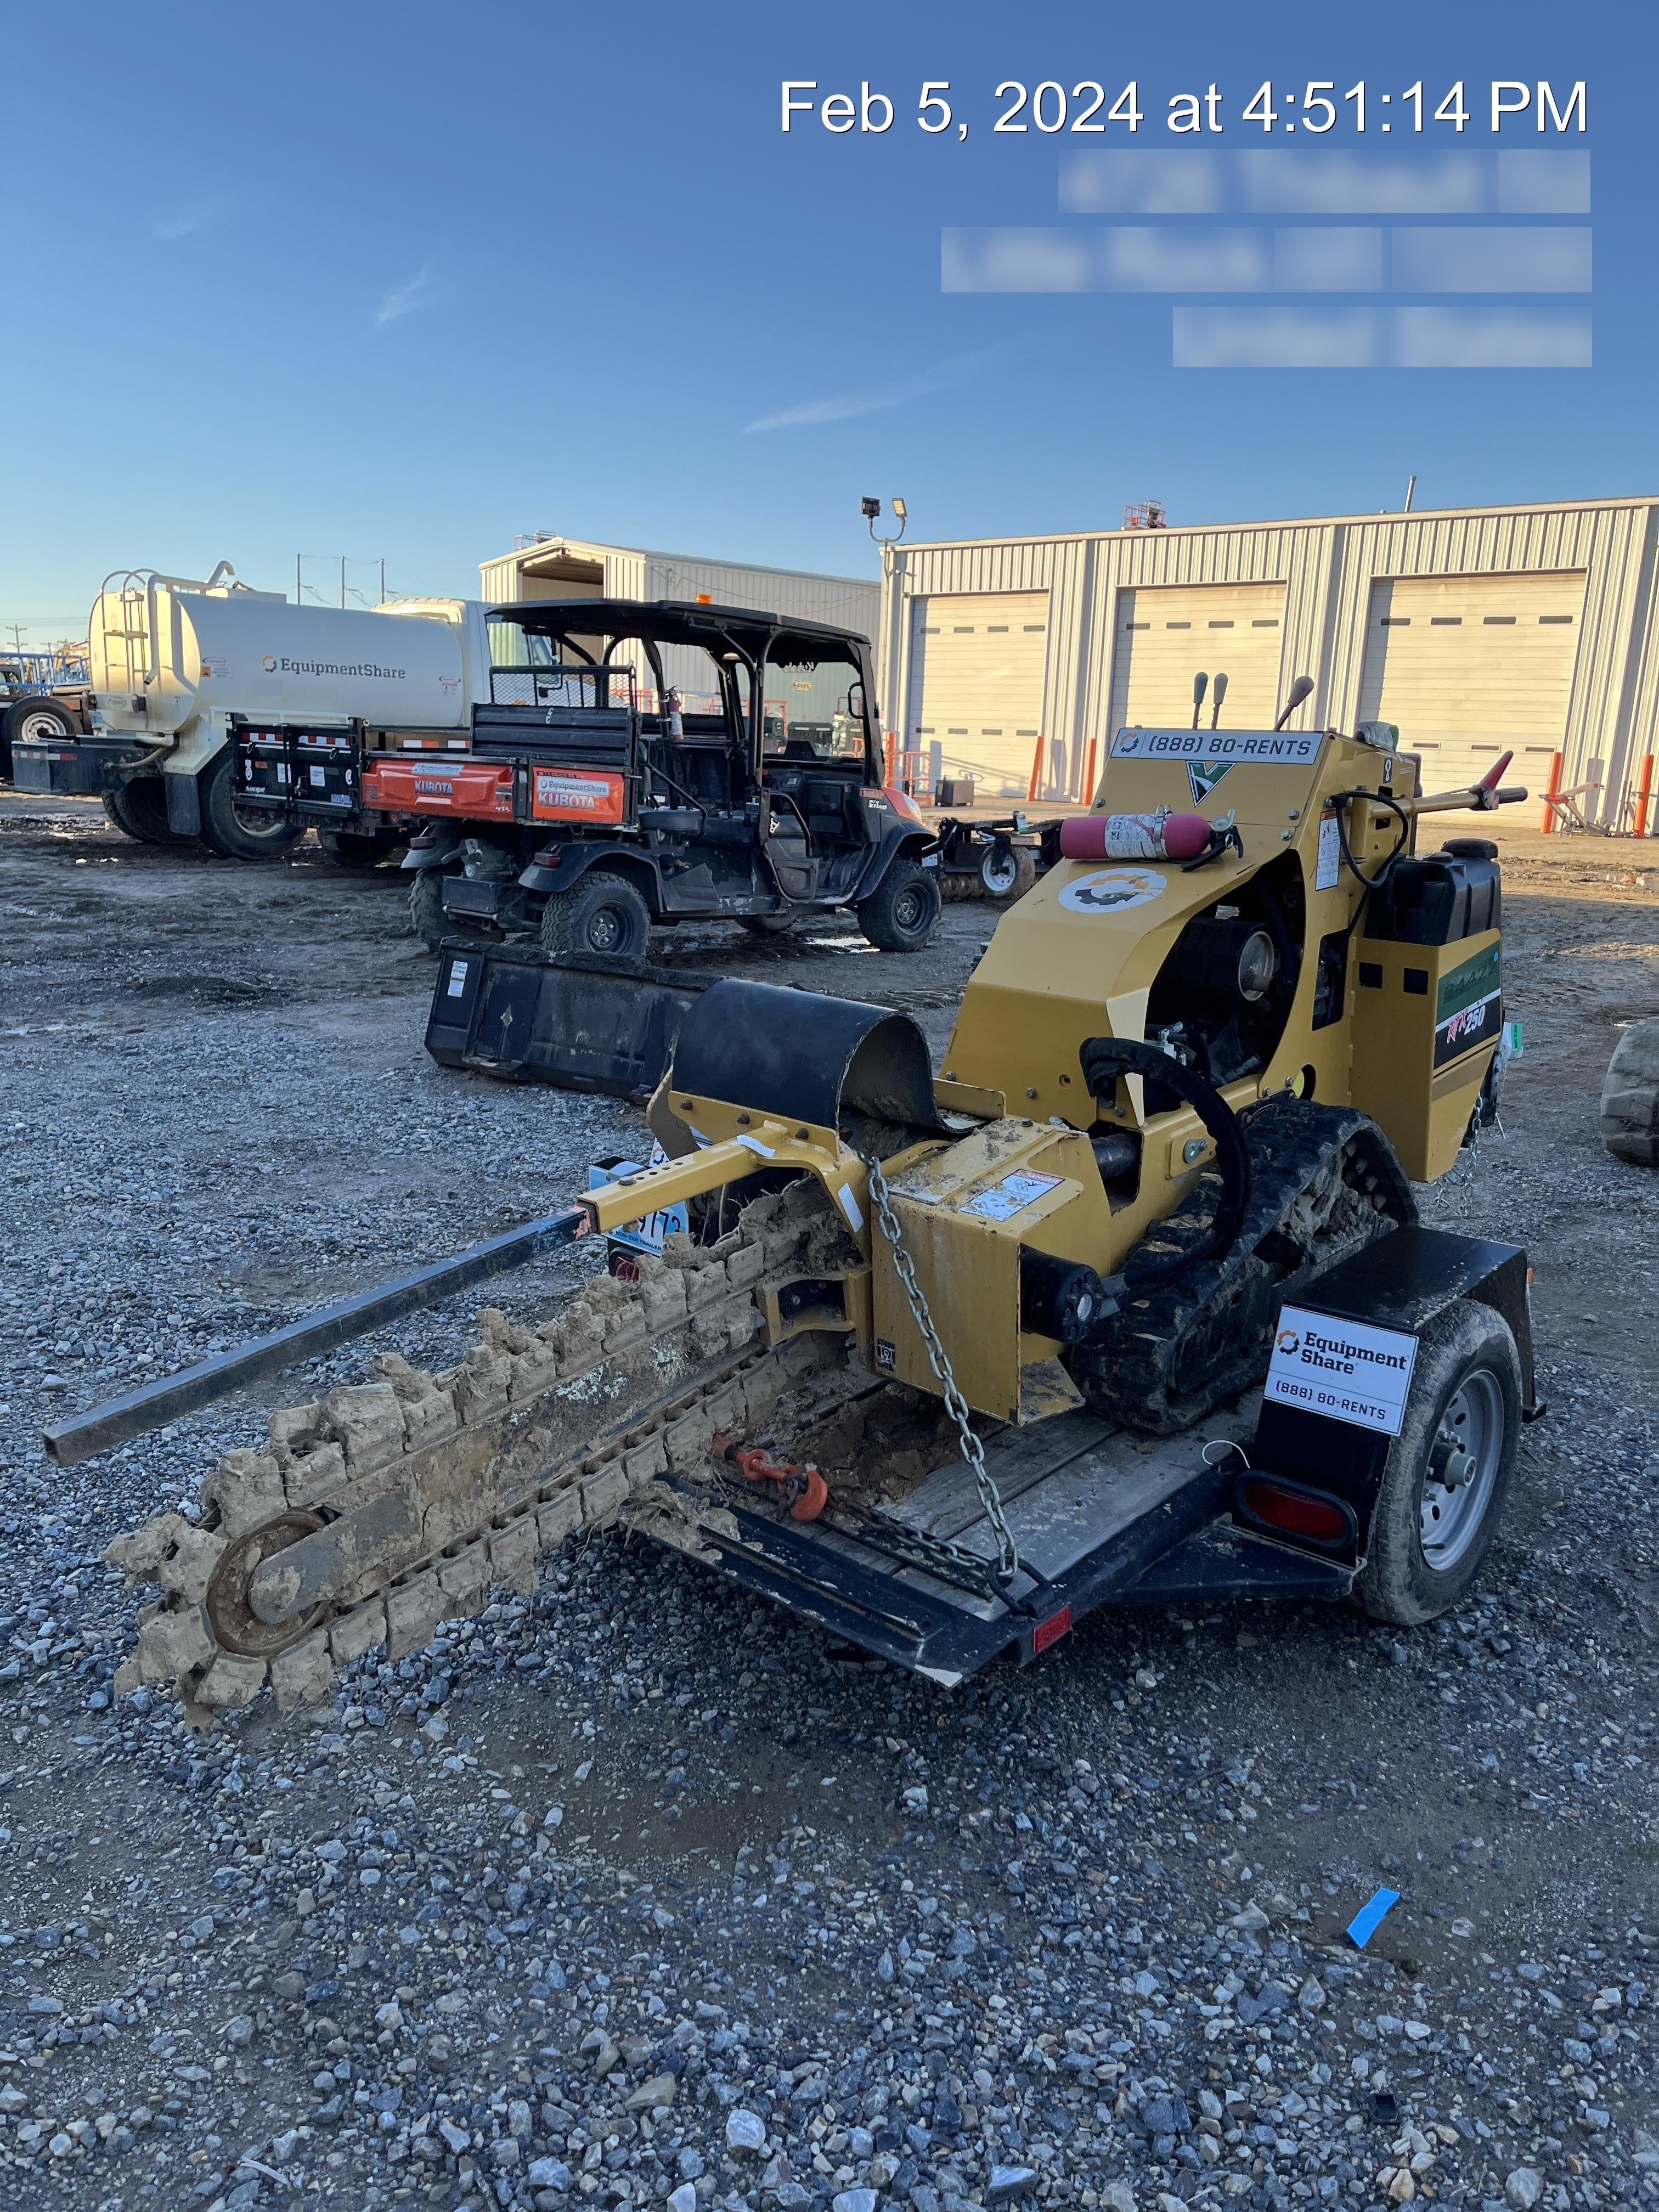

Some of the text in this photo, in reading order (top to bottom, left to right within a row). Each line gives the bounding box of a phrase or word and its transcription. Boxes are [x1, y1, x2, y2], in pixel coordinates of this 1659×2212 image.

[280, 657, 406, 679] EquipmentShare
[1148, 735, 1312, 756] (888) 80-RENTS
[415, 780, 454, 795] KUBOTA
[549, 781, 607, 793] EquipmentShare
[538, 791, 596, 809] KUBOTA
[616, 1231, 662, 1251] NON EXP TRAILER
[1304, 1331, 1407, 1370] Equipment
[1300, 1348, 1354, 1375] Share
[1276, 1380, 1386, 1420] (888) 80-RENTS
